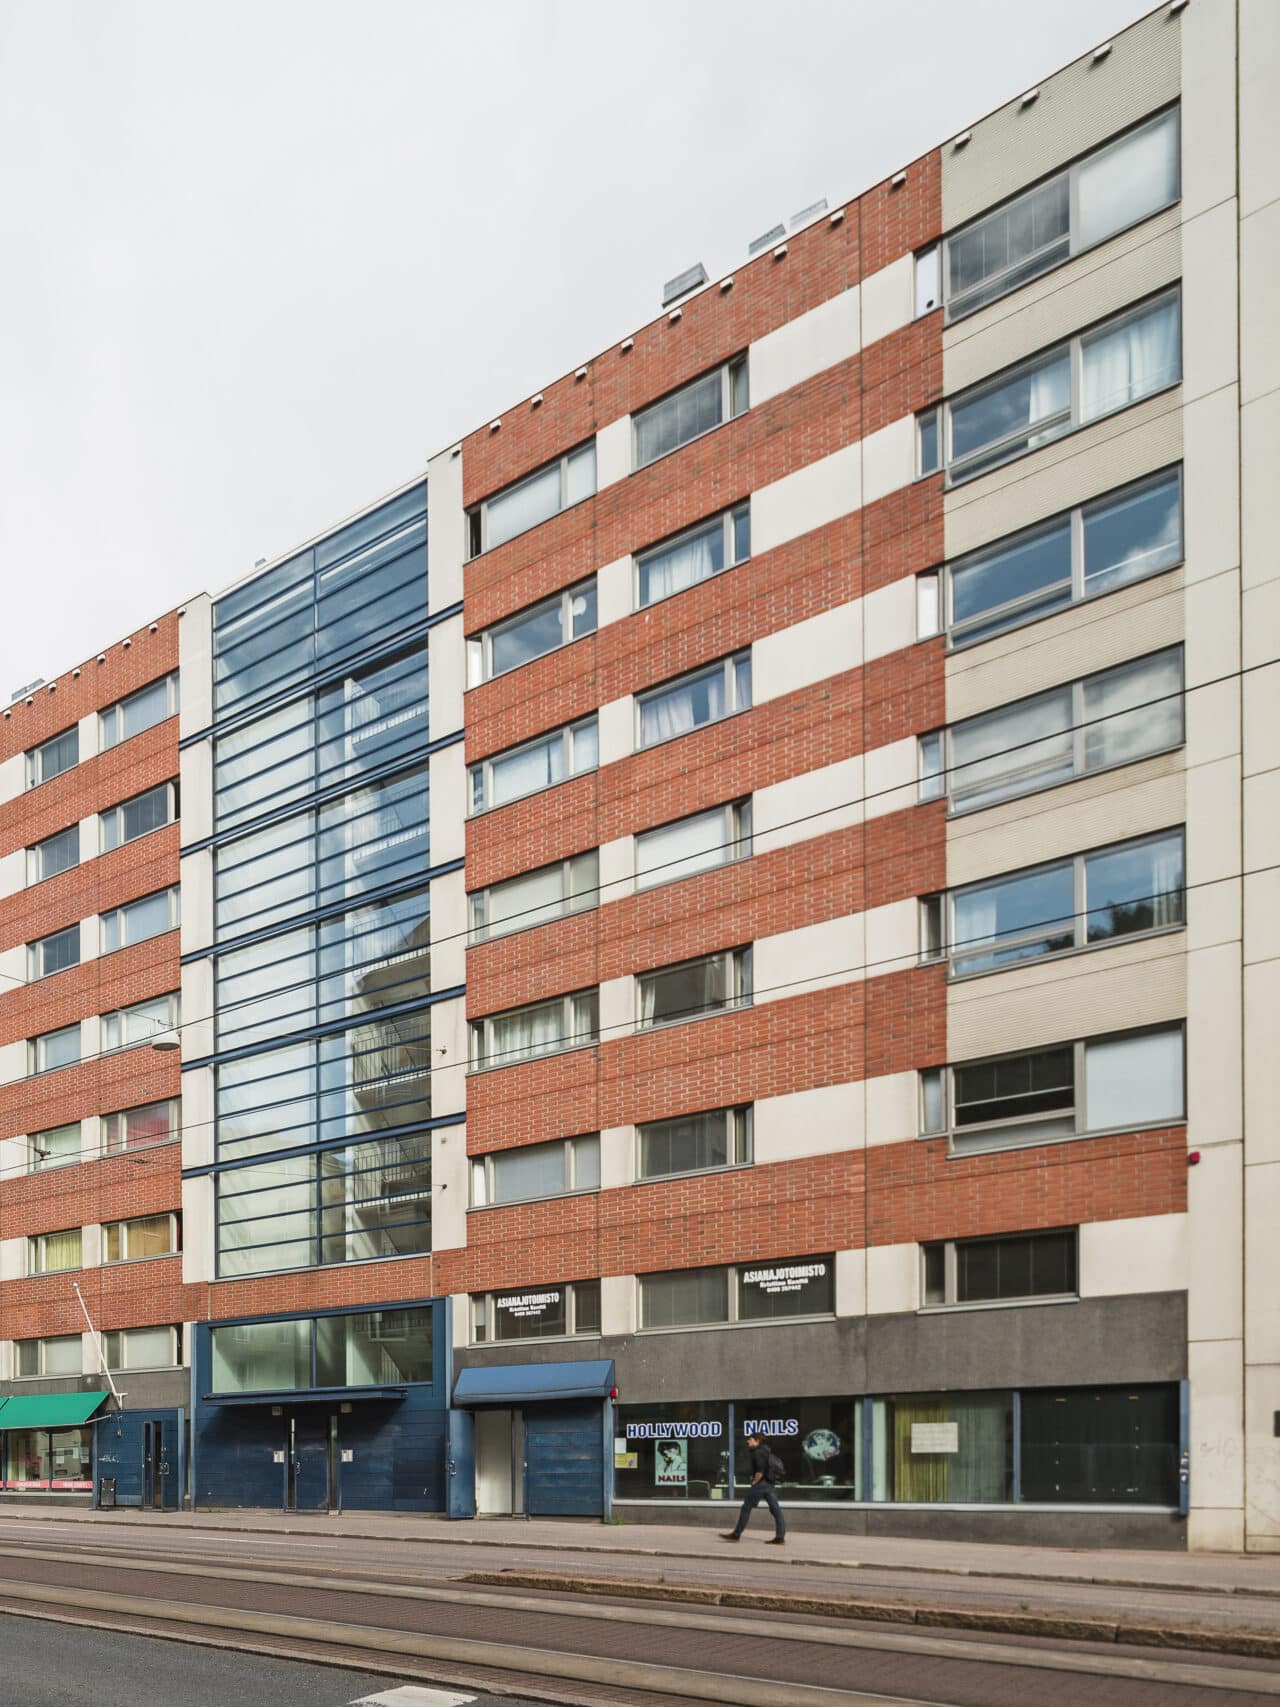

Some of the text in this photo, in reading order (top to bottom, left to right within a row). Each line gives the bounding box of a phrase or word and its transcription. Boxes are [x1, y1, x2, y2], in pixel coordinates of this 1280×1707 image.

[744, 1264, 826, 1283] ASIANAJOTOIMISTO
[497, 1292, 560, 1308] ASIANAJOTOIMISTO
[626, 1419, 799, 1438] HOLLYWOOD NAILS
